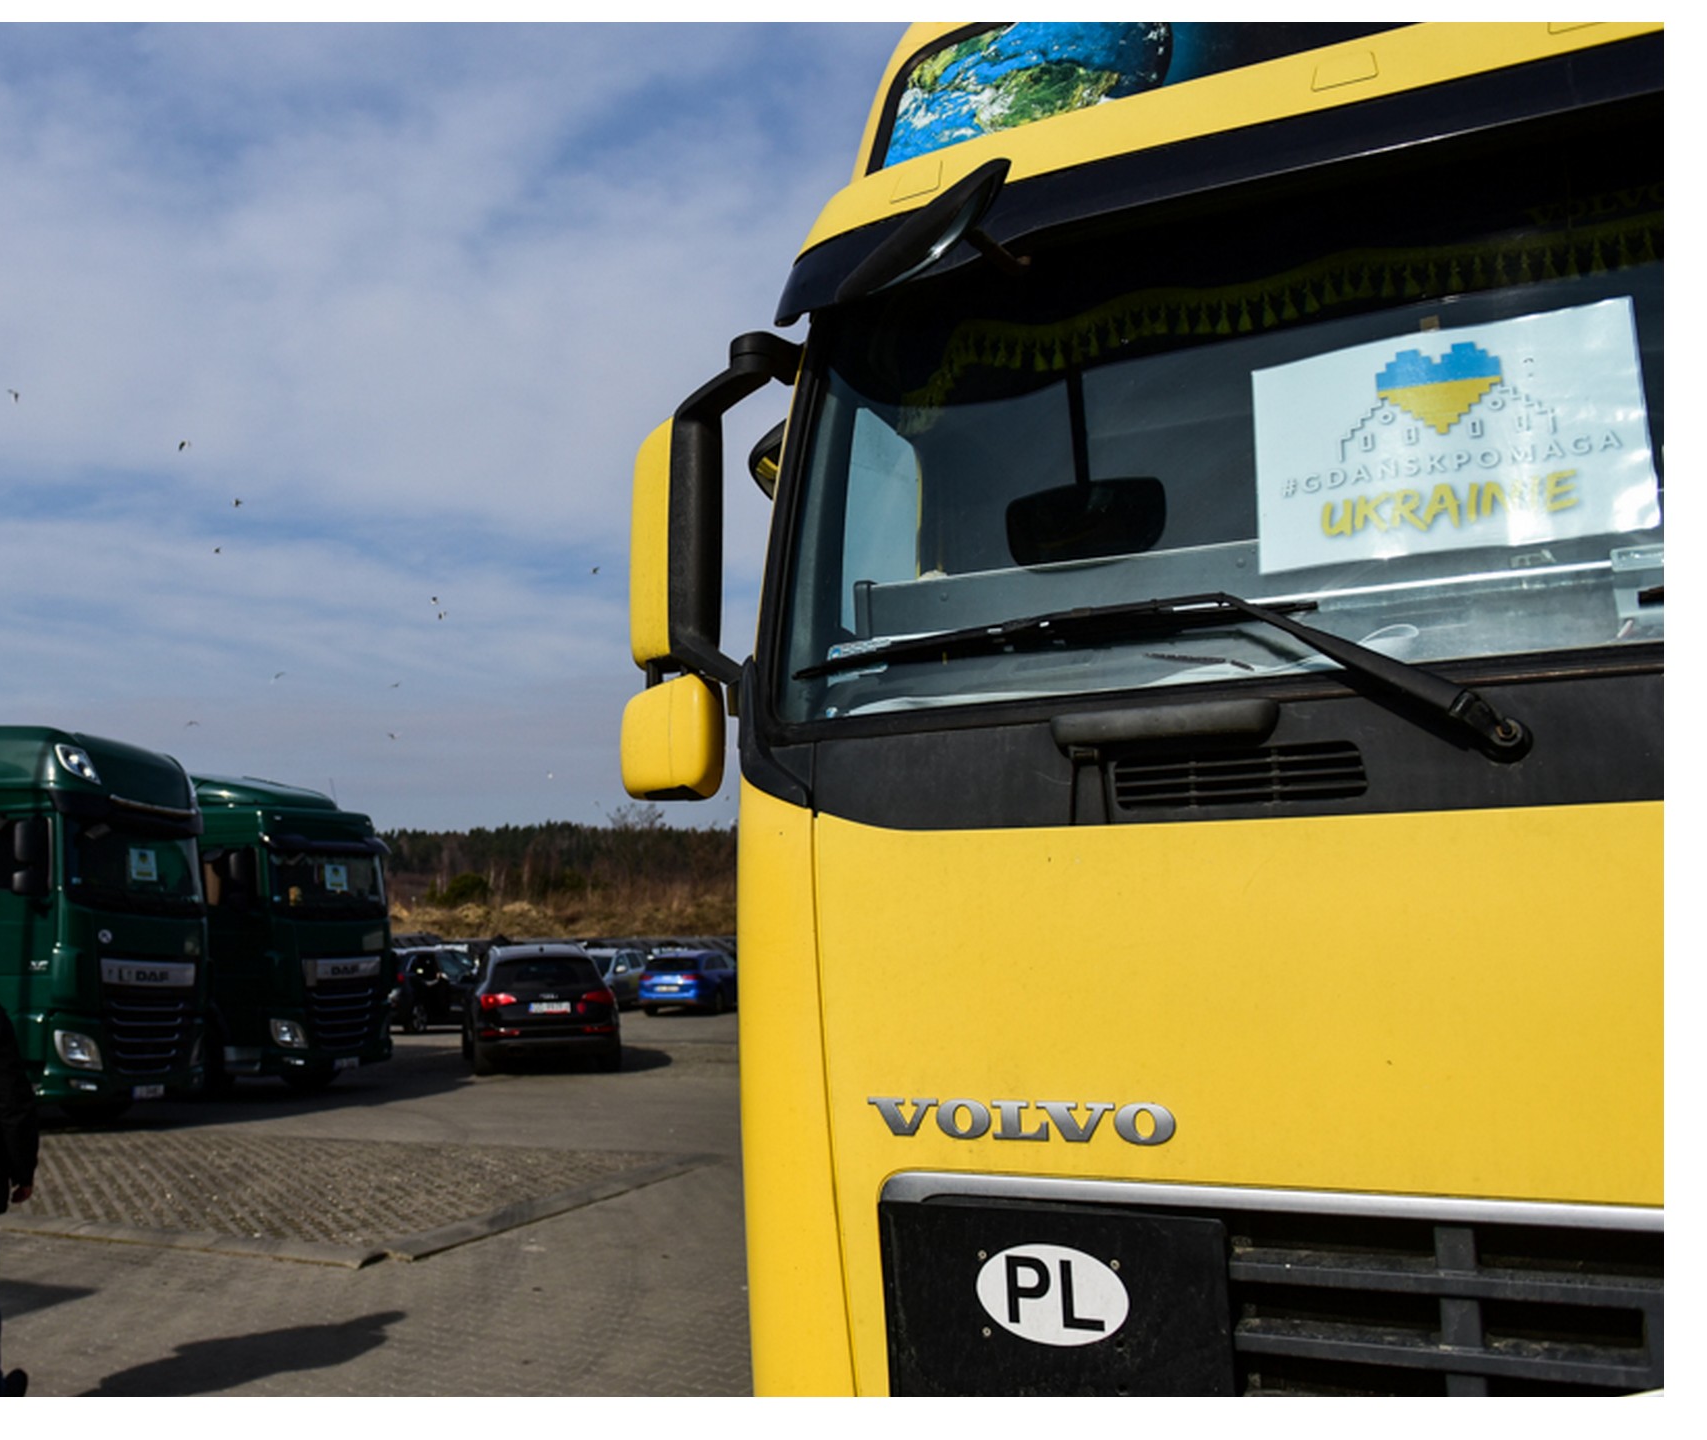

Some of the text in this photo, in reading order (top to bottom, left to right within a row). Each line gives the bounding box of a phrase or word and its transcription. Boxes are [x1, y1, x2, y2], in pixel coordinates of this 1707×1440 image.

[1319, 468, 1581, 539] UKRAINIE
[135, 969, 169, 983] DAF
[867, 1097, 1177, 1147] VOLVO
[1004, 1255, 1106, 1335] PL
